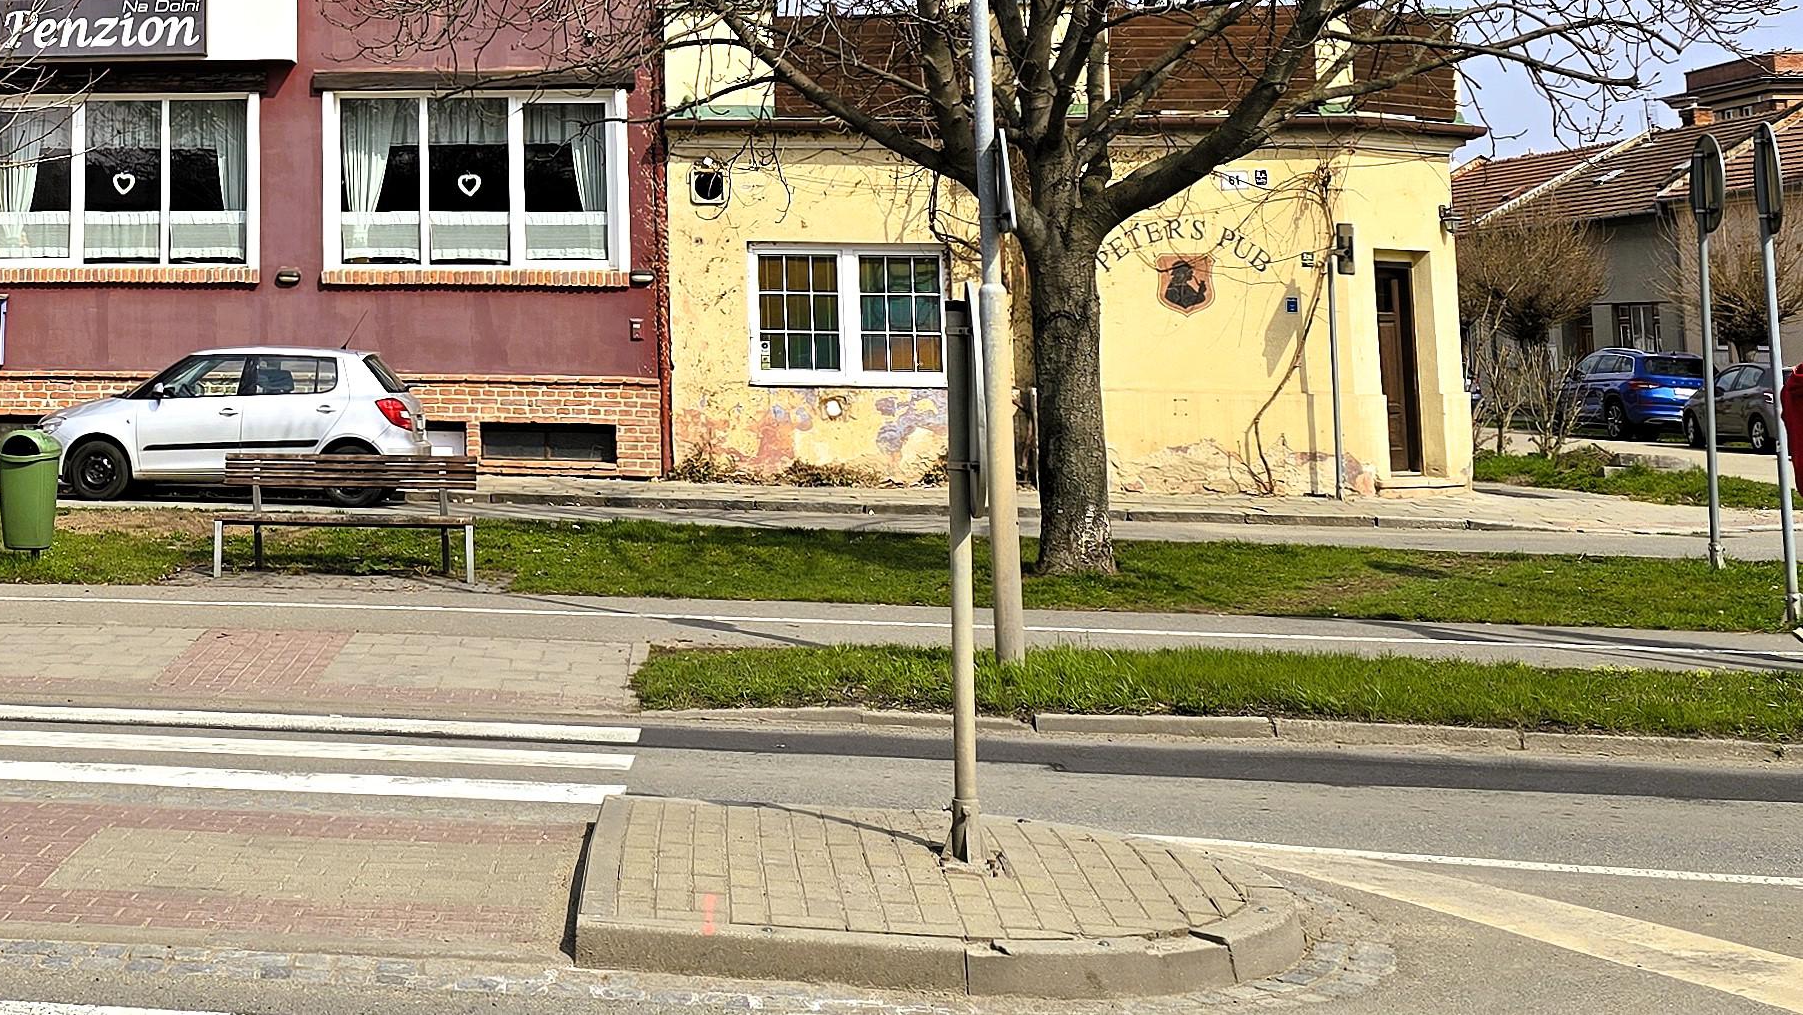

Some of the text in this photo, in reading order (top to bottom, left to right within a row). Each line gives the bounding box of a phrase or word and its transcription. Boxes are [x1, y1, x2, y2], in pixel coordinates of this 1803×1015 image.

[122, 0, 149, 13] Na
[3, 9, 201, 49] Penzion
[1216, 226, 1272, 273] PUB
